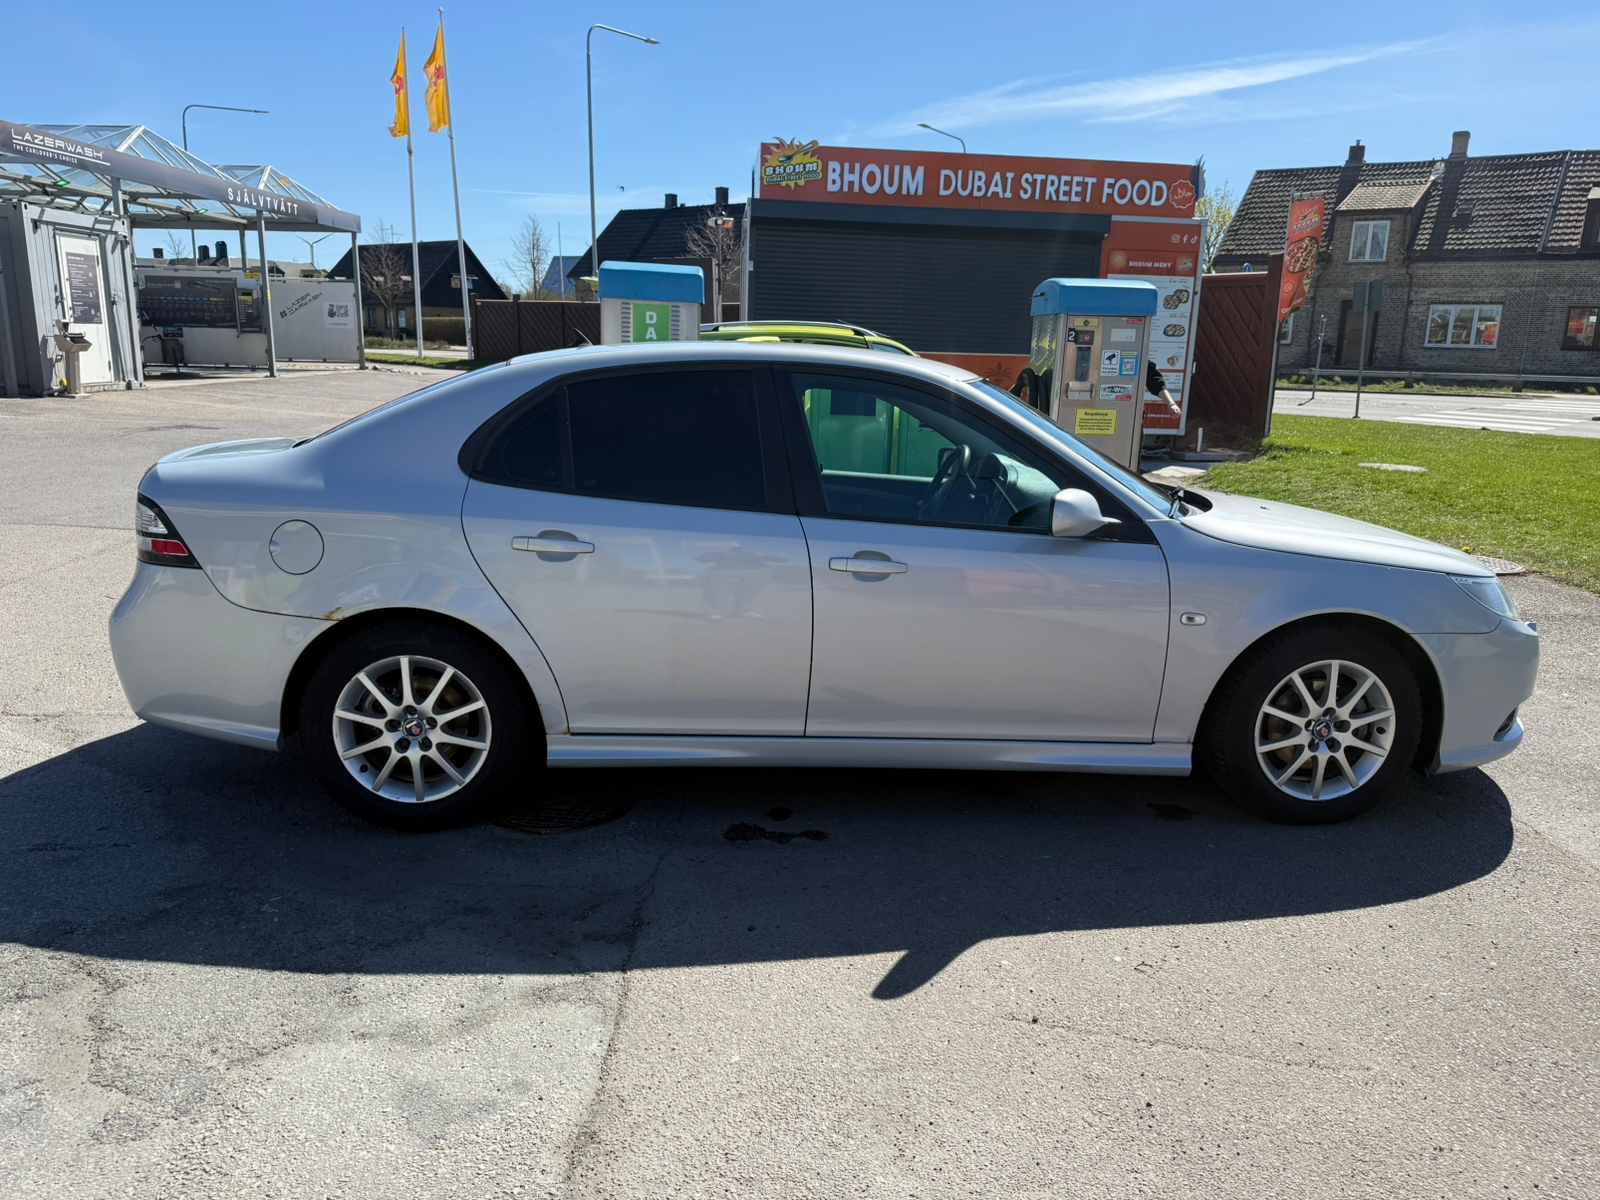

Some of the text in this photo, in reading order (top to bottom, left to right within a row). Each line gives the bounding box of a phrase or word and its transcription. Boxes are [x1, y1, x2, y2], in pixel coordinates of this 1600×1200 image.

[11, 128, 103, 159] LAZERWASH
[13, 144, 24, 152] THE
[59, 155, 78, 164] CHOICE
[765, 162, 818, 176] BHOUM
[827, 161, 1168, 206] BHOUM DUBAI STREET FOOD
[1173, 187, 1192, 200] حلال
[227, 187, 298, 216] SJÄLVTVÄTT
[1128, 260, 1153, 269] BHOUM
[1153, 261, 1172, 269] MENY
[288, 291, 324, 316] CARWASH
[1068, 330, 1076, 341] 2
